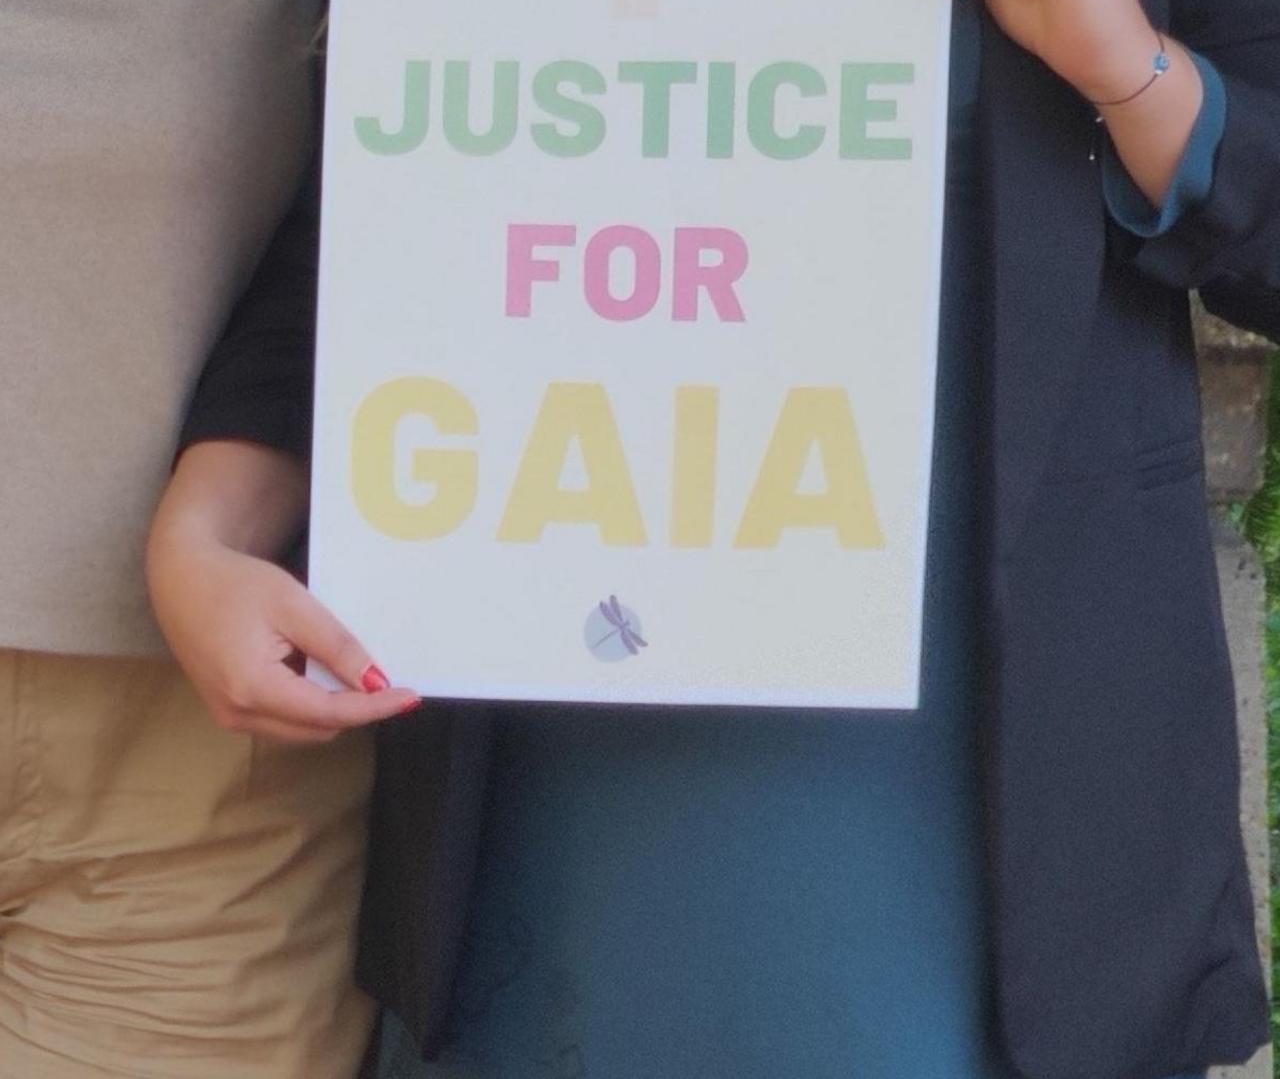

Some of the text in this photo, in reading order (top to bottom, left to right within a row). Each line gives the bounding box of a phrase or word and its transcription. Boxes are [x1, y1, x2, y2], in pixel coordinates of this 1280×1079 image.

[354, 59, 916, 161] JUSTICE
[505, 223, 749, 323] FOR
[350, 376, 887, 550] GAIA
